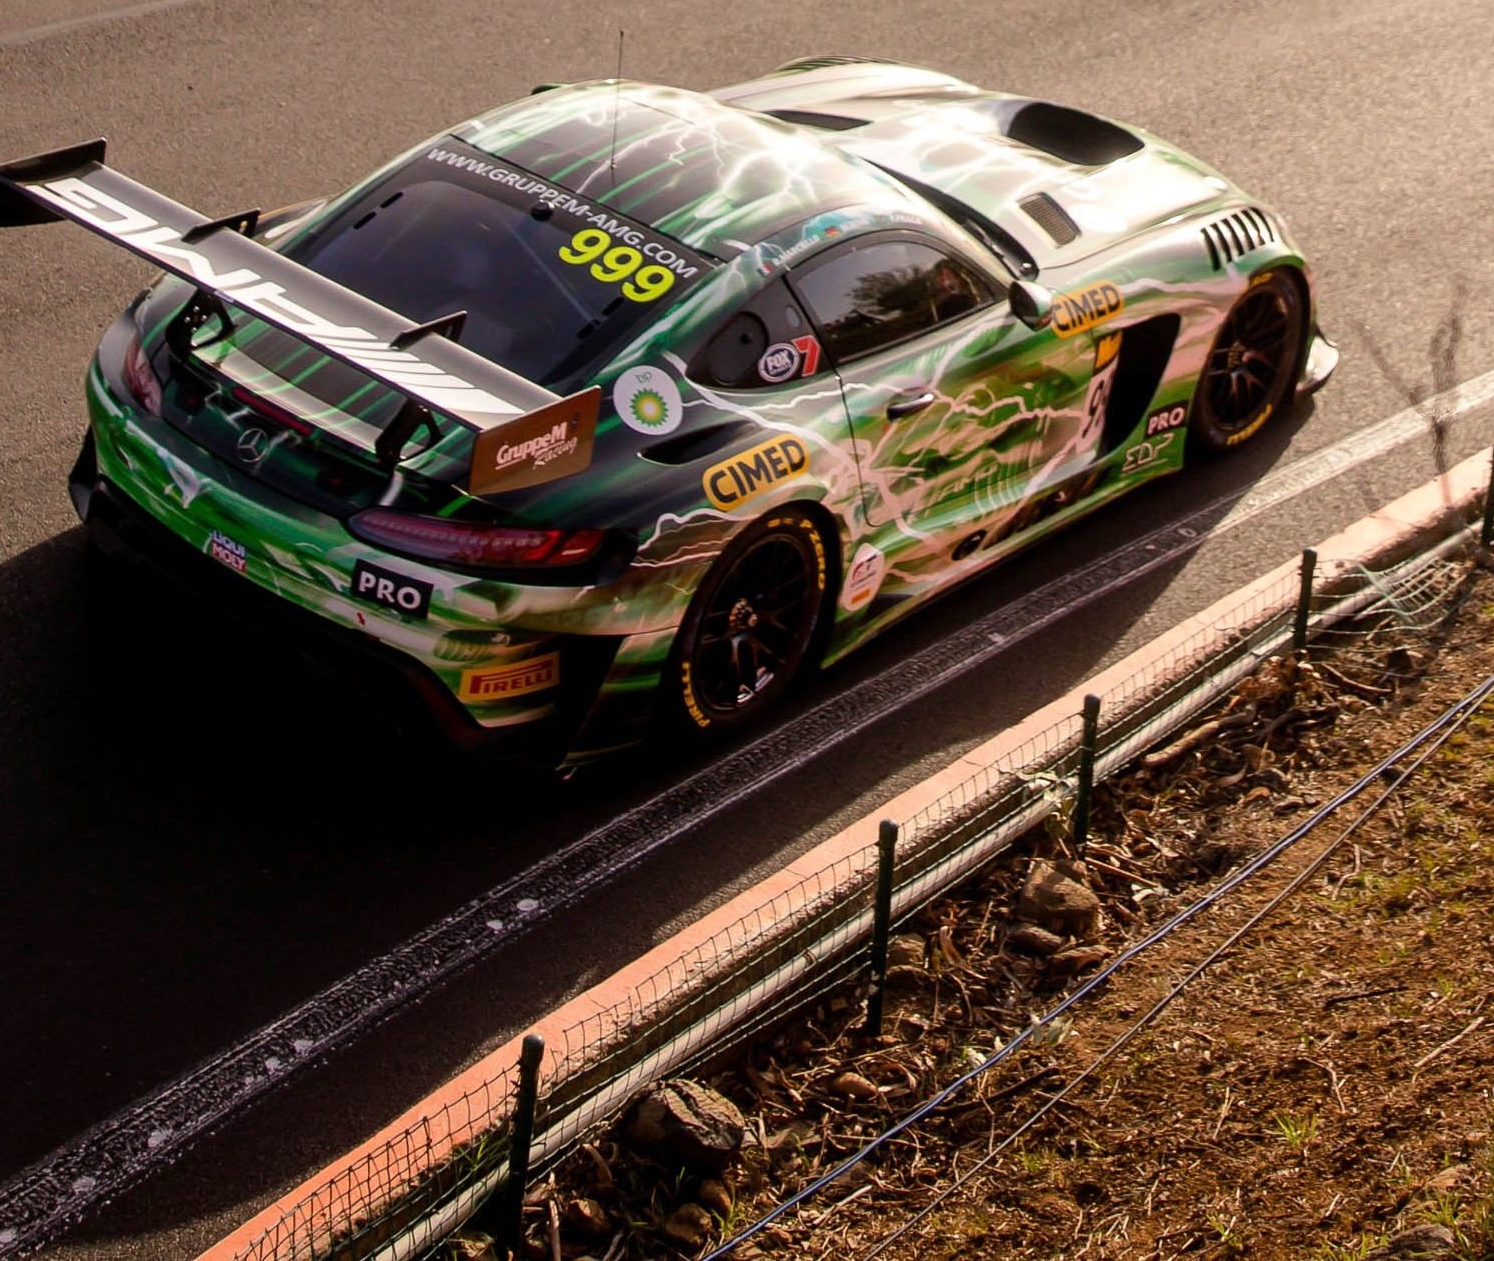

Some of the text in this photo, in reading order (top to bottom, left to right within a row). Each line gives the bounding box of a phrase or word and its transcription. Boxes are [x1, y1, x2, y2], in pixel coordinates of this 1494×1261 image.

[427, 148, 698, 278] WWW.GRUPPEM-AMG.COM
[558, 228, 675, 303] 999
[1053, 285, 1121, 332] CIMED
[495, 421, 567, 466] GruppeM
[1147, 407, 1185, 435] PRO
[709, 439, 805, 504] CIMED
[211, 541, 247, 571] MOLY
[359, 570, 422, 610] PRO
[469, 657, 554, 695] PIRELLI
